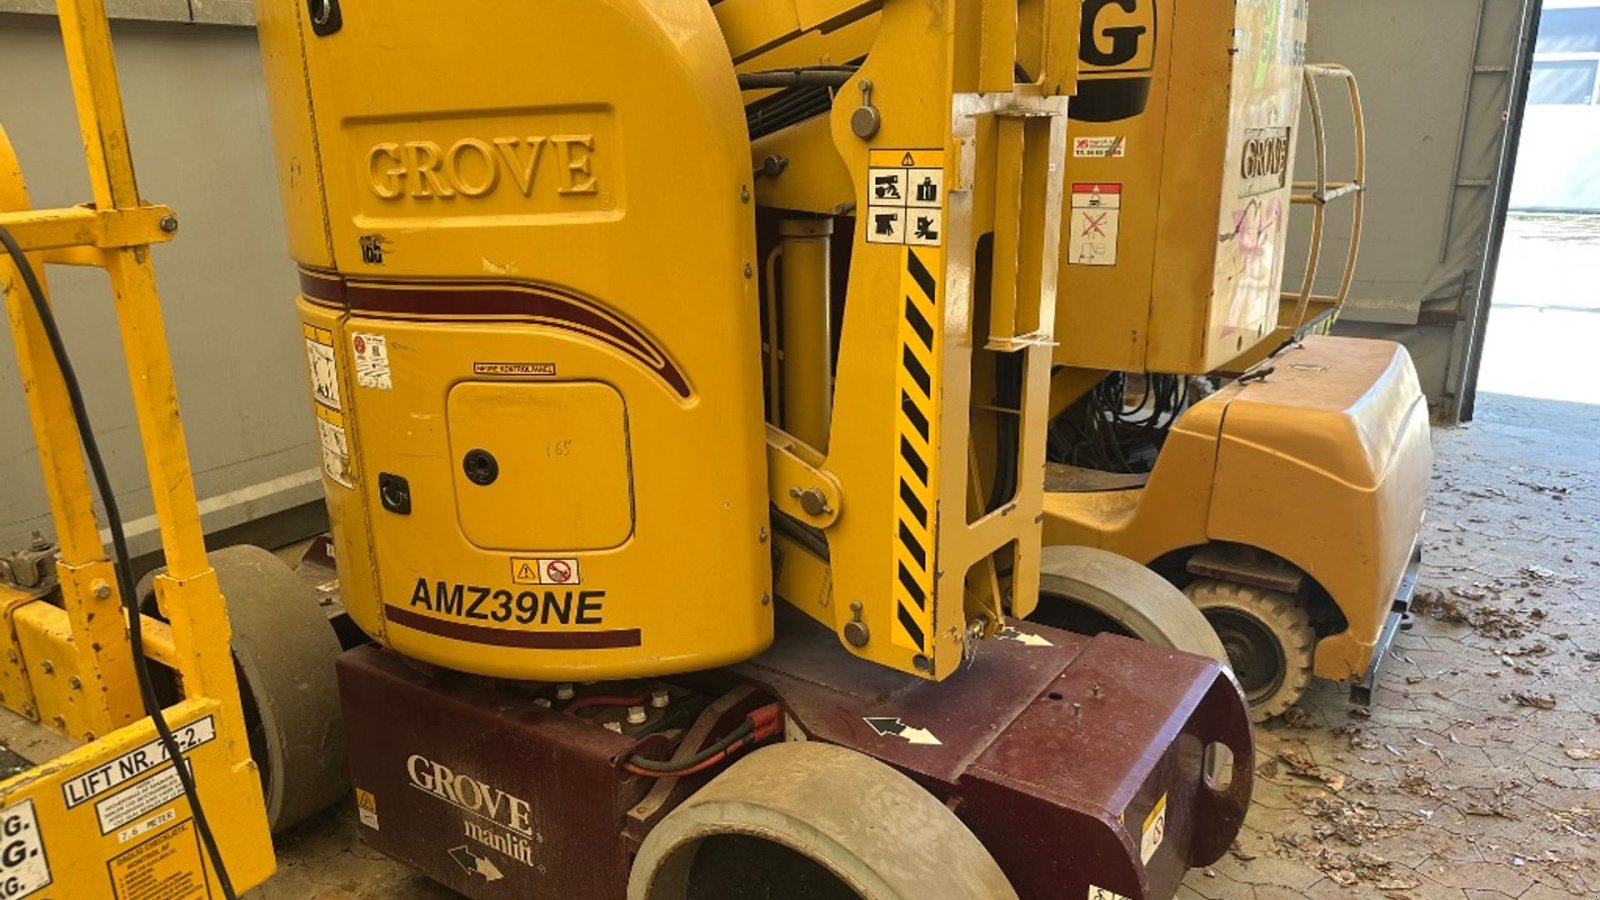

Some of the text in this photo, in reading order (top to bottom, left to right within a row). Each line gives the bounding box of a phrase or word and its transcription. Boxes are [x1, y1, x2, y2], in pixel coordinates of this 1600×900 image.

[1079, 0, 1146, 67] G
[366, 134, 599, 200] GROVE
[1241, 137, 1286, 180] GROVE
[410, 577, 605, 625] AMZ39NE
[69, 766, 112, 804] LIFT
[118, 750, 154, 779] NR.
[406, 754, 533, 836] GROVE
[146, 810, 174, 829] METER
[464, 820, 534, 867] manlift
